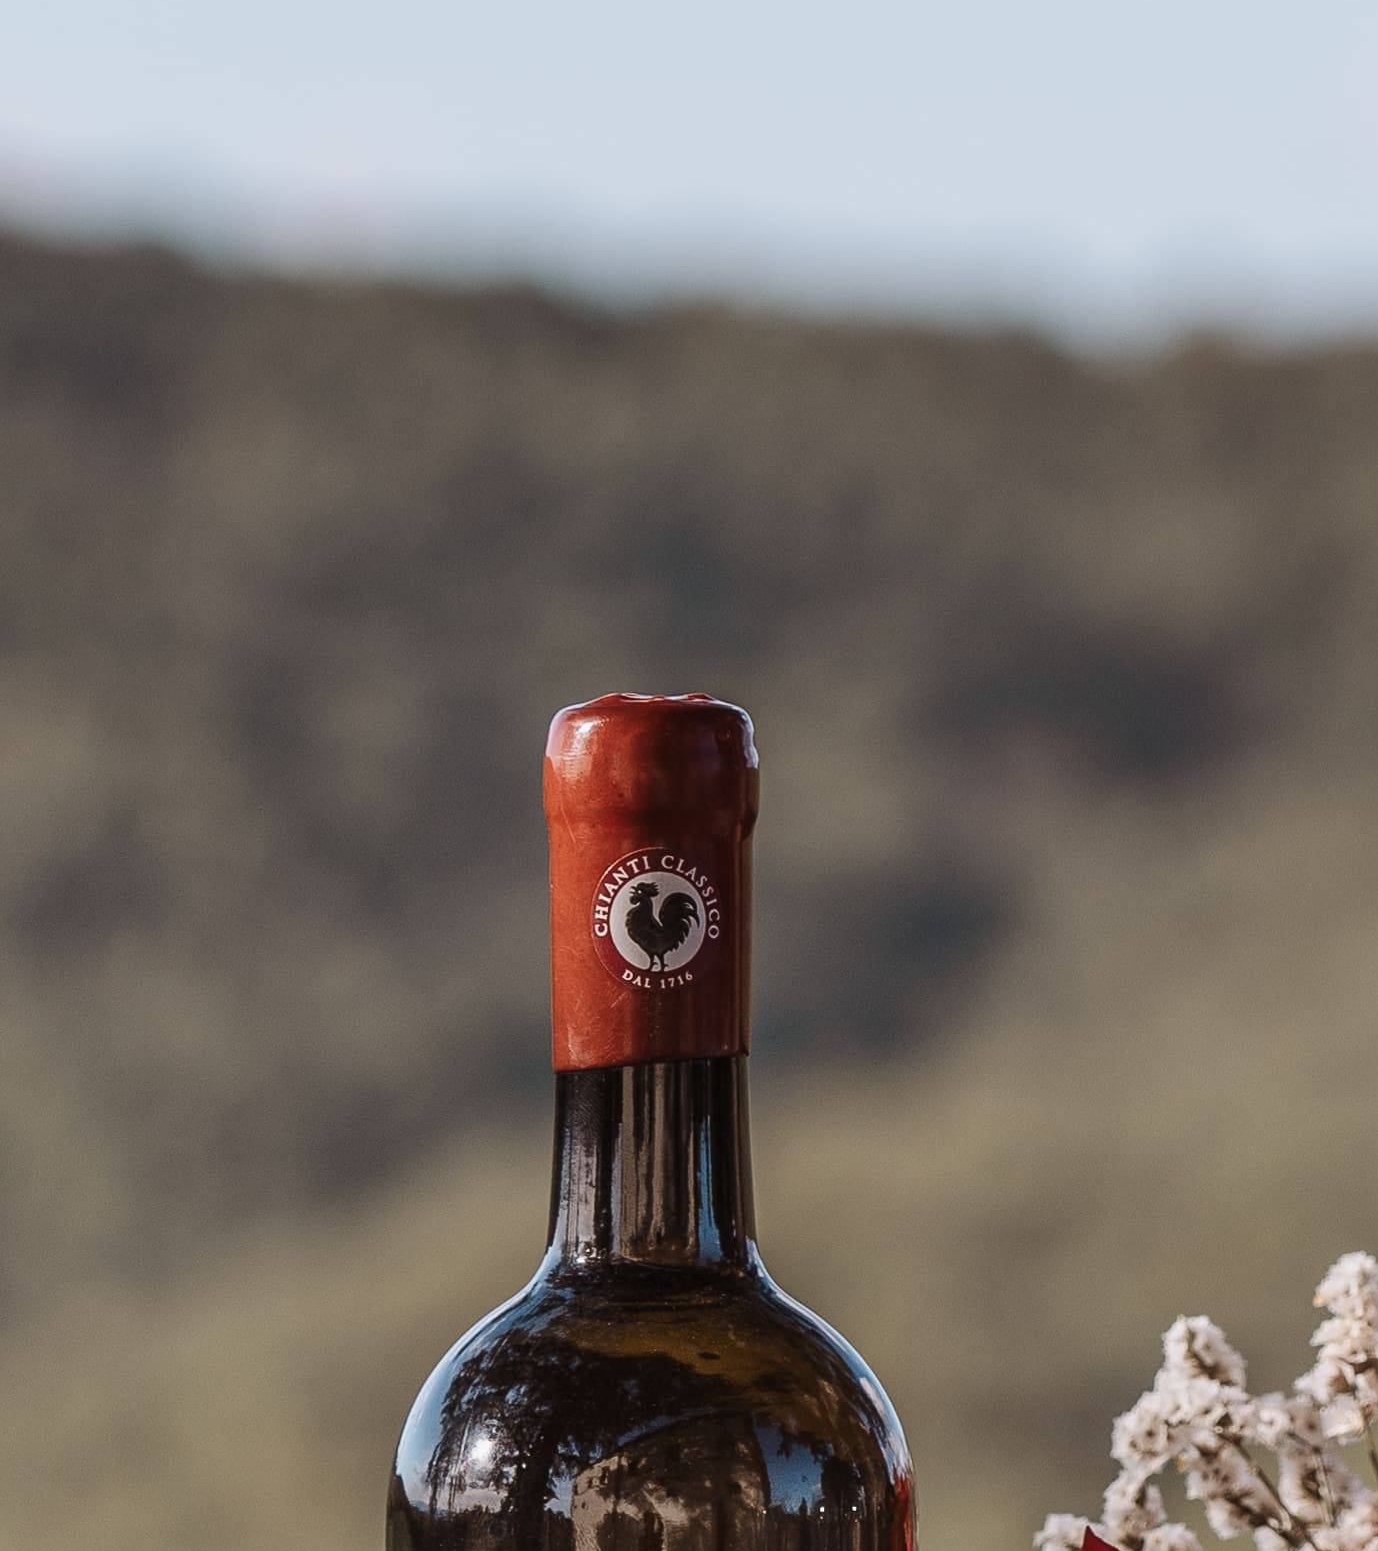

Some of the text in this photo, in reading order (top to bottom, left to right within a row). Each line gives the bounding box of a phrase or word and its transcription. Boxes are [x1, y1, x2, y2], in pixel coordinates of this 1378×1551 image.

[594, 855, 721, 940] CHIANTI CLASSICO
[622, 969, 693, 990] DAL 1716
